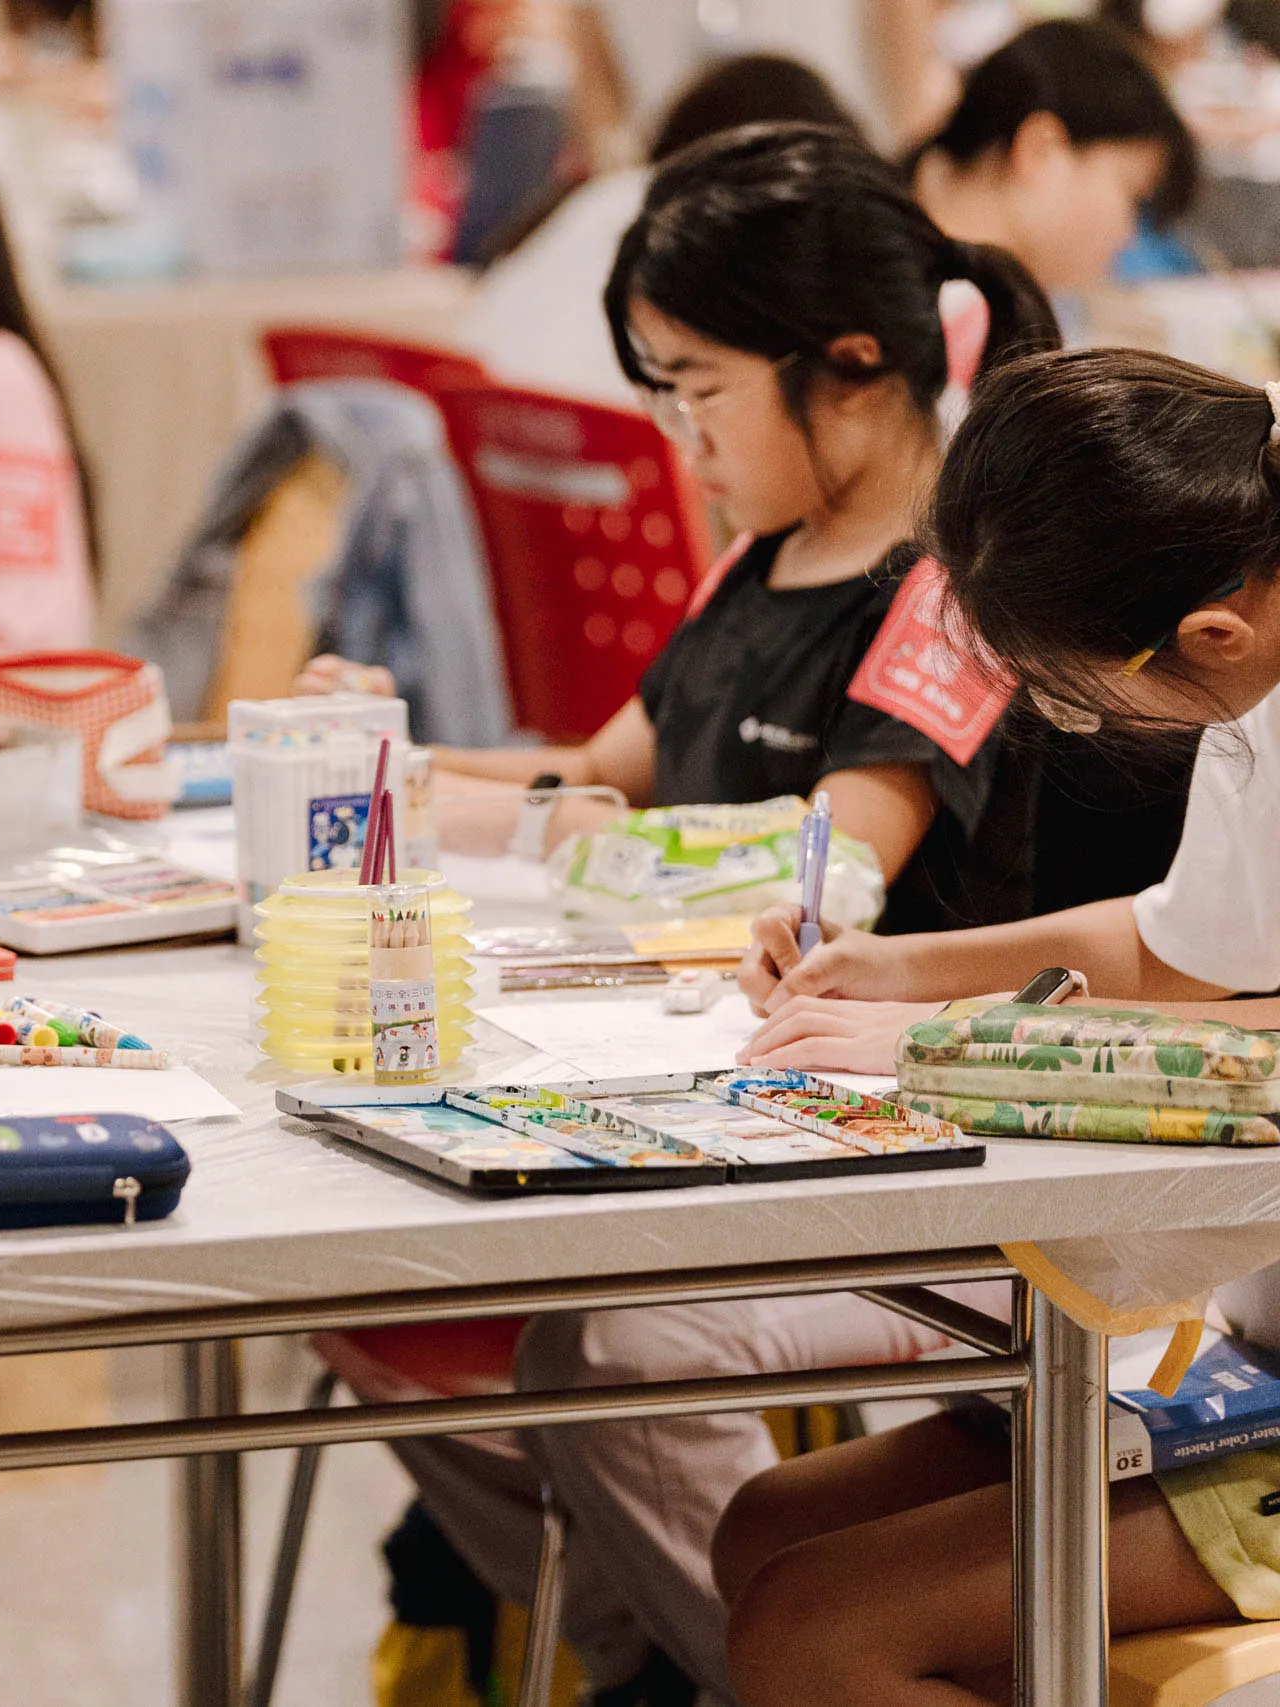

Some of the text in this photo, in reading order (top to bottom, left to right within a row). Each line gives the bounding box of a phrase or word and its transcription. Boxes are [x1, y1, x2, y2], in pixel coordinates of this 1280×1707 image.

[1216, 1433, 1249, 1448] Color
[1174, 1441, 1215, 1457] Palette
[1116, 1453, 1143, 1471] 30
